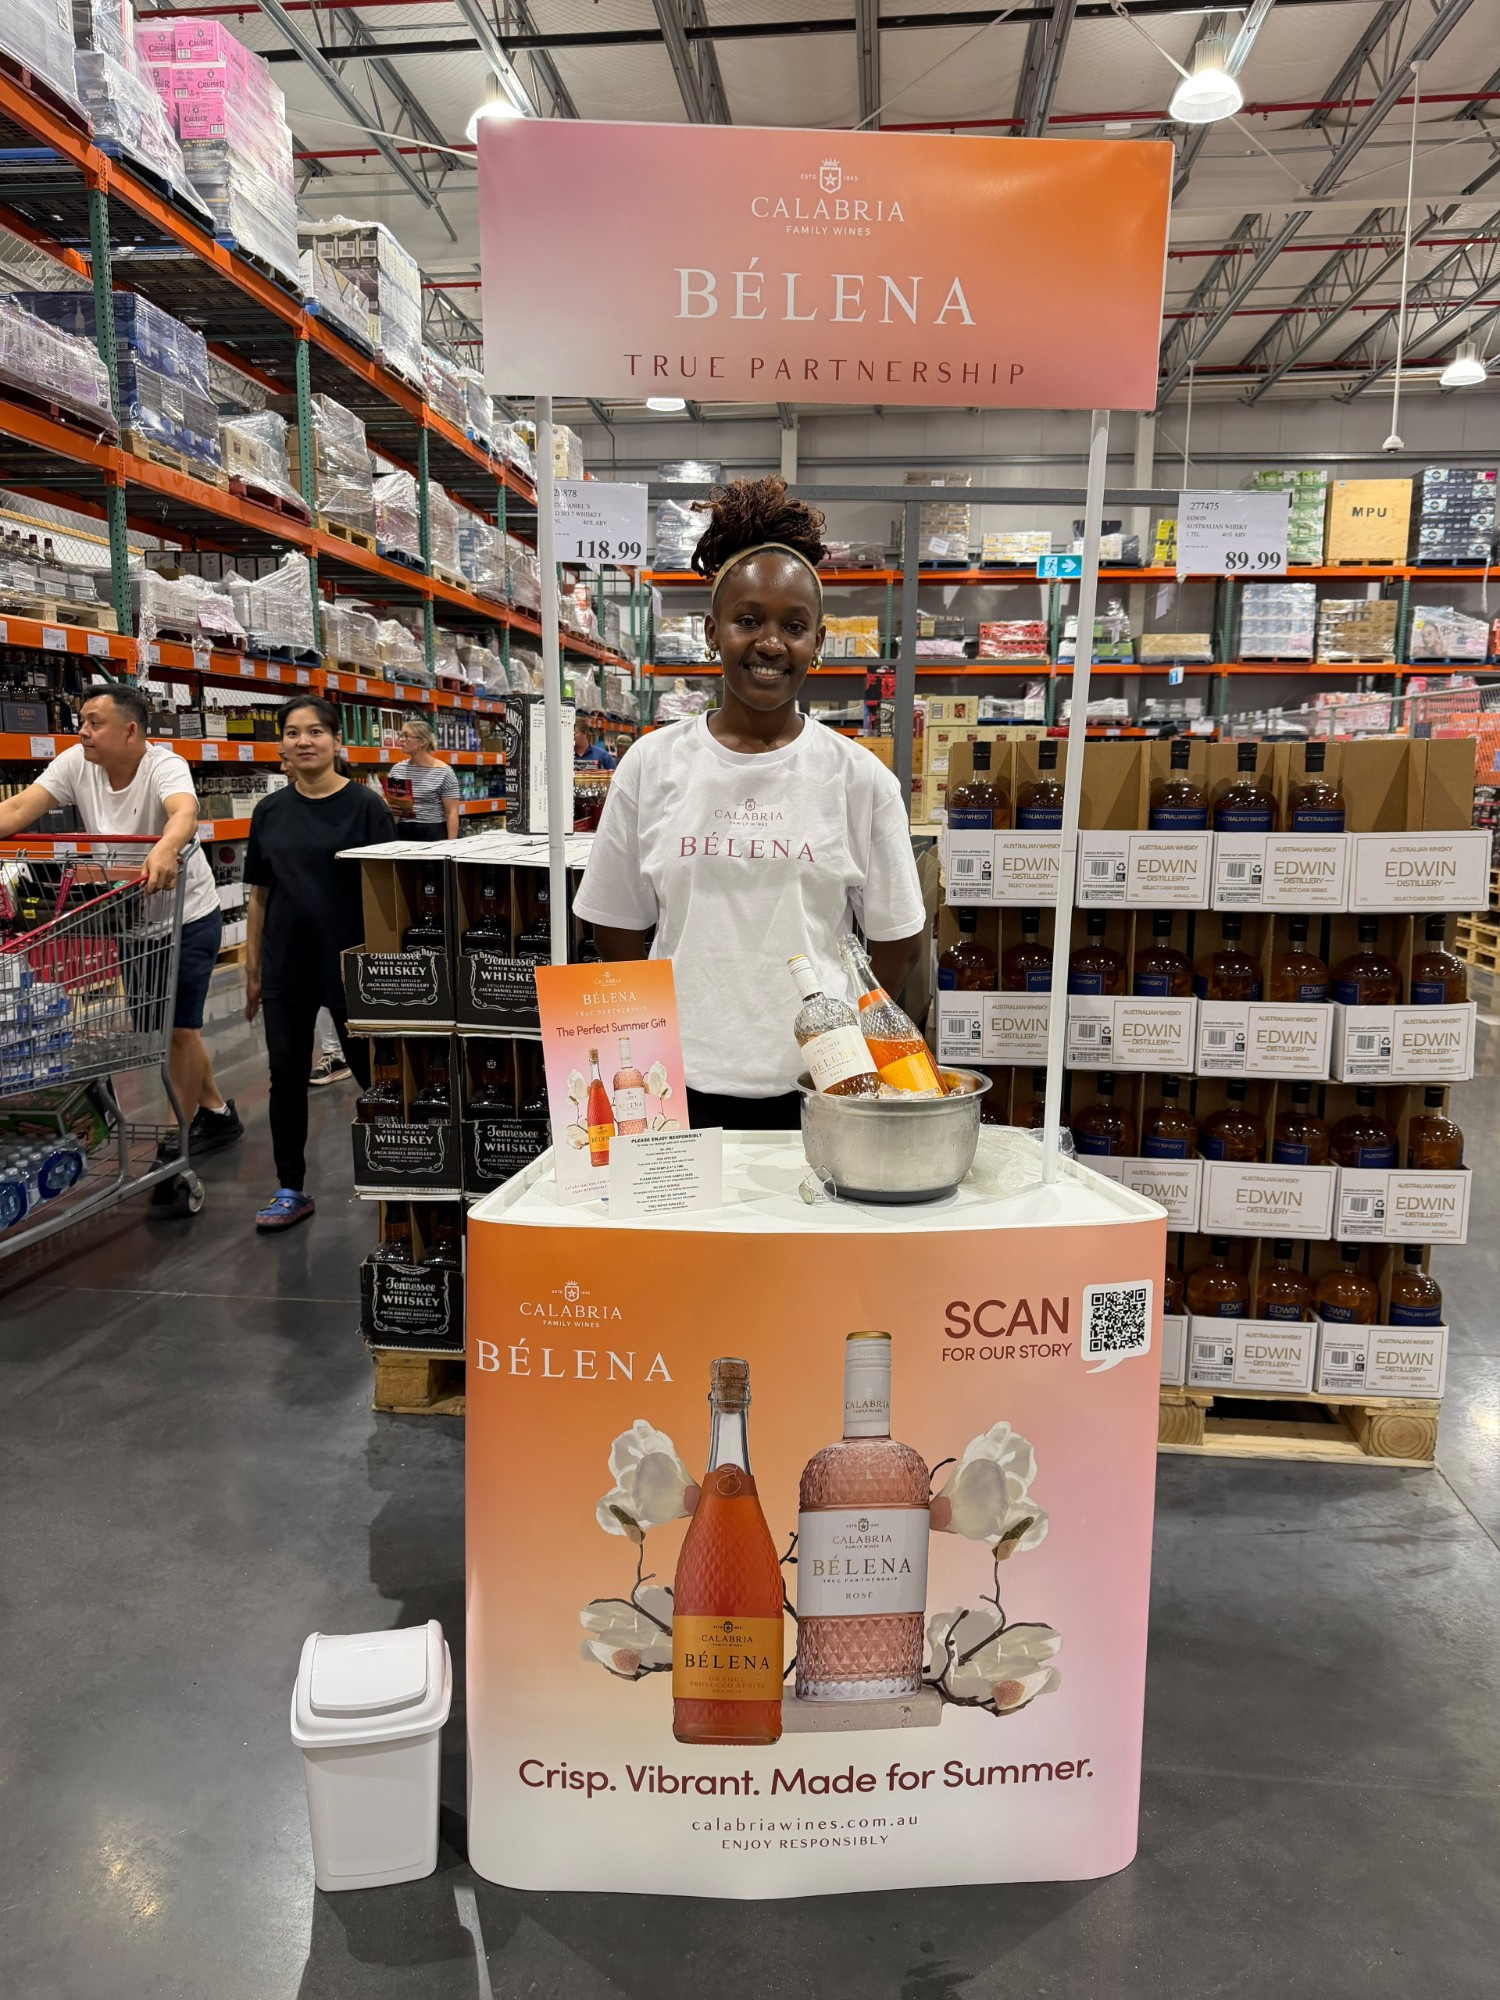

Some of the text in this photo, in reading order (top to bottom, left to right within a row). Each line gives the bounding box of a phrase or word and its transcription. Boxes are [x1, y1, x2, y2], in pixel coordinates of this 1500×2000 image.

[751, 196, 905, 222] CALABRIA
[786, 225, 871, 236] FAMILY WINES
[673, 256, 976, 325] BÉLENA
[623, 354, 1025, 384] TRUE PARTNERSHIP
[1190, 502, 1219, 510] 277475
[1352, 507, 1387, 518] MPU
[576, 540, 641, 560] 118.99
[1225, 552, 1281, 569] 89.99
[714, 810, 783, 821] CALABRIA
[679, 832, 815, 862] BÉLENA
[1003, 858, 1059, 871] EDWIN
[1137, 860, 1197, 873] EDWIN
[1274, 862, 1335, 875] EDWIN
[1385, 861, 1456, 877] EDWIN
[368, 966, 426, 975] WHISKEY
[583, 991, 637, 1005] BÉLENA
[556, 1018, 667, 1037] The Perfect Summer Gift
[992, 1018, 1047, 1031] EDWIN
[1123, 1024, 1181, 1037] EDWIN
[1257, 1030, 1317, 1044] EDWIN
[1403, 1032, 1460, 1046] EDWIN
[487, 1125, 539, 1138] Tennessee
[375, 1135, 433, 1144] WHISKEY
[484, 1143, 543, 1153] WHISKEY
[1131, 1183, 1188, 1197] EDWIN
[1236, 1189, 1302, 1206] EDWIN
[1396, 1197, 1455, 1210] EDWIN
[386, 1277, 436, 1291] Tennessee
[382, 1295, 440, 1307] WHISKEY
[519, 1302, 622, 1320] CALABRIA
[1269, 1304, 1299, 1314] EDWIN
[944, 1297, 1069, 1339] SCAN
[942, 1343, 1072, 1361] FOR OUR STORY
[1244, 1346, 1301, 1360] EDWIN
[1376, 1351, 1433, 1365] EDWIN
[476, 1338, 674, 1382] BÉLENA
[845, 1400, 890, 1409] CALABRIA
[833, 1535, 892, 1544] CALABRIA
[812, 1555, 912, 1577] BÉLENA
[845, 1591, 873, 1600] ROSÉ
[702, 1635, 753, 1643] CALABRIA
[685, 1651, 769, 1670] BÉLENA
[518, 1758, 1094, 1799] Crisp. Vibrant. Made for Summer.
[691, 1814, 919, 1832] calabriawines.com.au
[721, 1834, 889, 1851] ENJOY RESPONSIBLY
